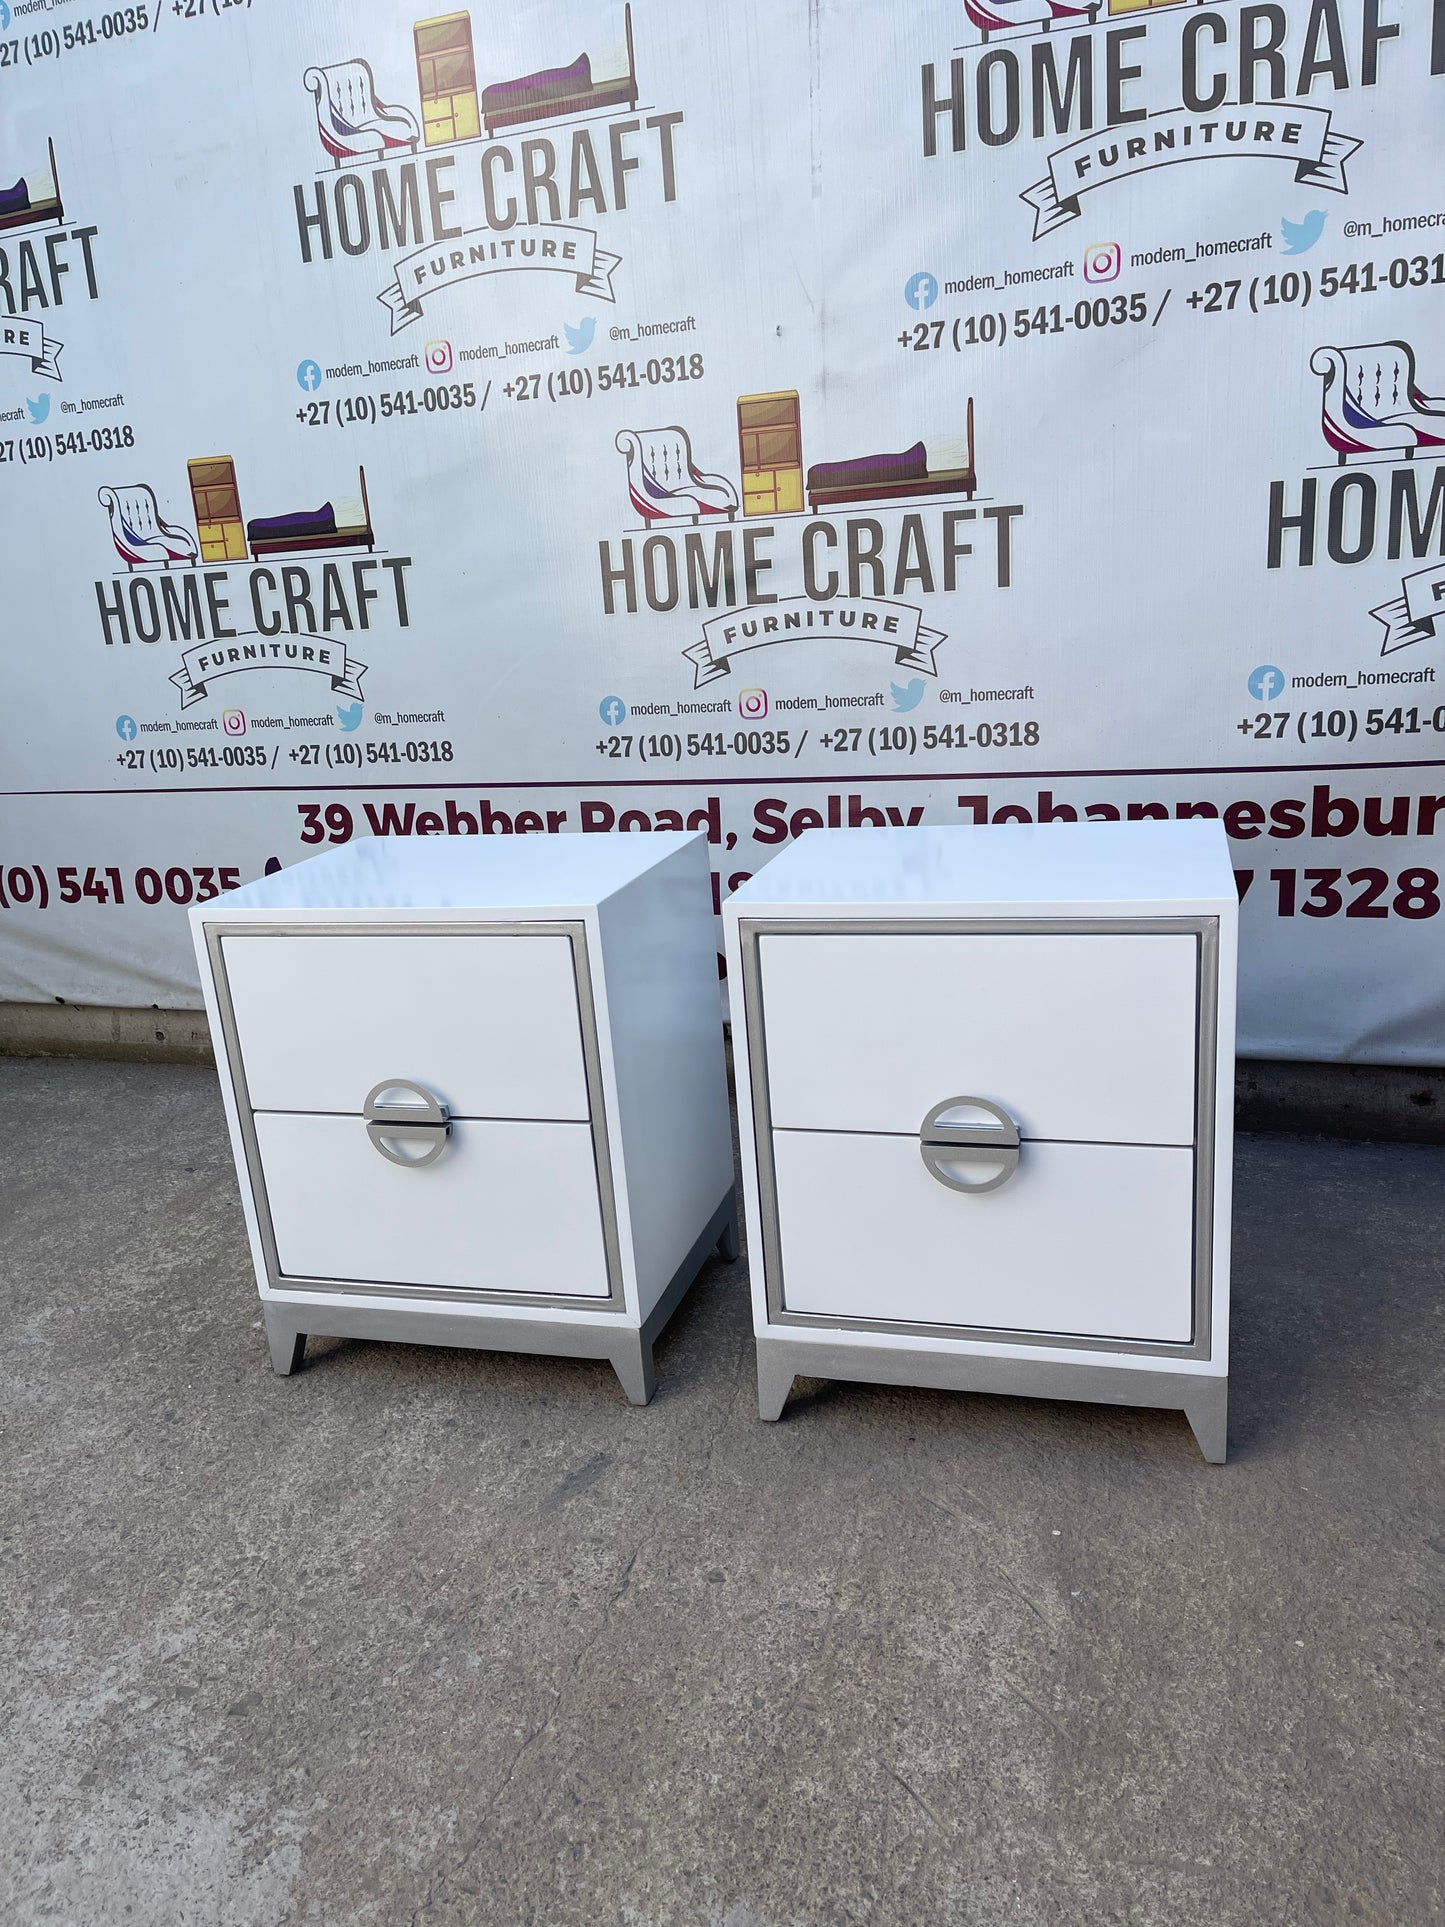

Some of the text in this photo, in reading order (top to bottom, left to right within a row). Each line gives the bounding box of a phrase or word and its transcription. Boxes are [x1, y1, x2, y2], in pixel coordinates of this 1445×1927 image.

[25, 29, 60, 66] (10)
[63, 5, 149, 50] 541-0035
[921, 0, 1445, 157] HOME CRAF
[1074, 120, 1303, 179] FURNITURE
[293, 111, 684, 263] HOME CRAFT
[414, 240, 577, 284] FURNITURE
[897, 320, 945, 351] +27
[952, 312, 1007, 352] (10)
[1013, 292, 1147, 338] 541-0035
[1186, 279, 1242, 313] +27
[1249, 270, 1312, 313] (10)
[1319, 253, 1445, 298] 541-031
[609, 316, 696, 341] @m_homecraft
[60, 394, 125, 414] @m_homecraft
[296, 401, 330, 426] +27
[335, 396, 376, 428] (10)
[380, 382, 476, 417] 541-0035
[503, 374, 541, 401] +27
[547, 368, 593, 402] (10)
[598, 353, 704, 391] 541-0318
[19, 436, 53, 464] (10)
[55, 425, 135, 455] 541-0318
[598, 504, 1024, 615] HOME CRAFT
[95, 557, 412, 646] HOME CRAFT
[724, 610, 900, 644] FURNITURE
[198, 644, 331, 672] FURNITURE
[939, 686, 1034, 705] @m_homecraft
[374, 710, 445, 726] @m_homecraft
[1237, 712, 1290, 739] +27
[1297, 710, 1357, 744] (10)
[117, 750, 145, 769] +27
[150, 748, 184, 773] (10)
[187, 746, 267, 768] 541-0035
[289, 744, 320, 765] +27
[325, 743, 362, 769] (10)
[366, 740, 454, 763] 541-0318
[596, 735, 633, 758] +27
[639, 734, 682, 762] (10)
[687, 731, 790, 756] 541-0035
[820, 728, 862, 752] +27
[868, 726, 917, 756] (10)
[923, 721, 1040, 749] 541-0318
[298, 803, 354, 844] 39
[362, 799, 567, 836] Webber
[57, 867, 125, 904] 541
[1270, 867, 1441, 919] 1328
